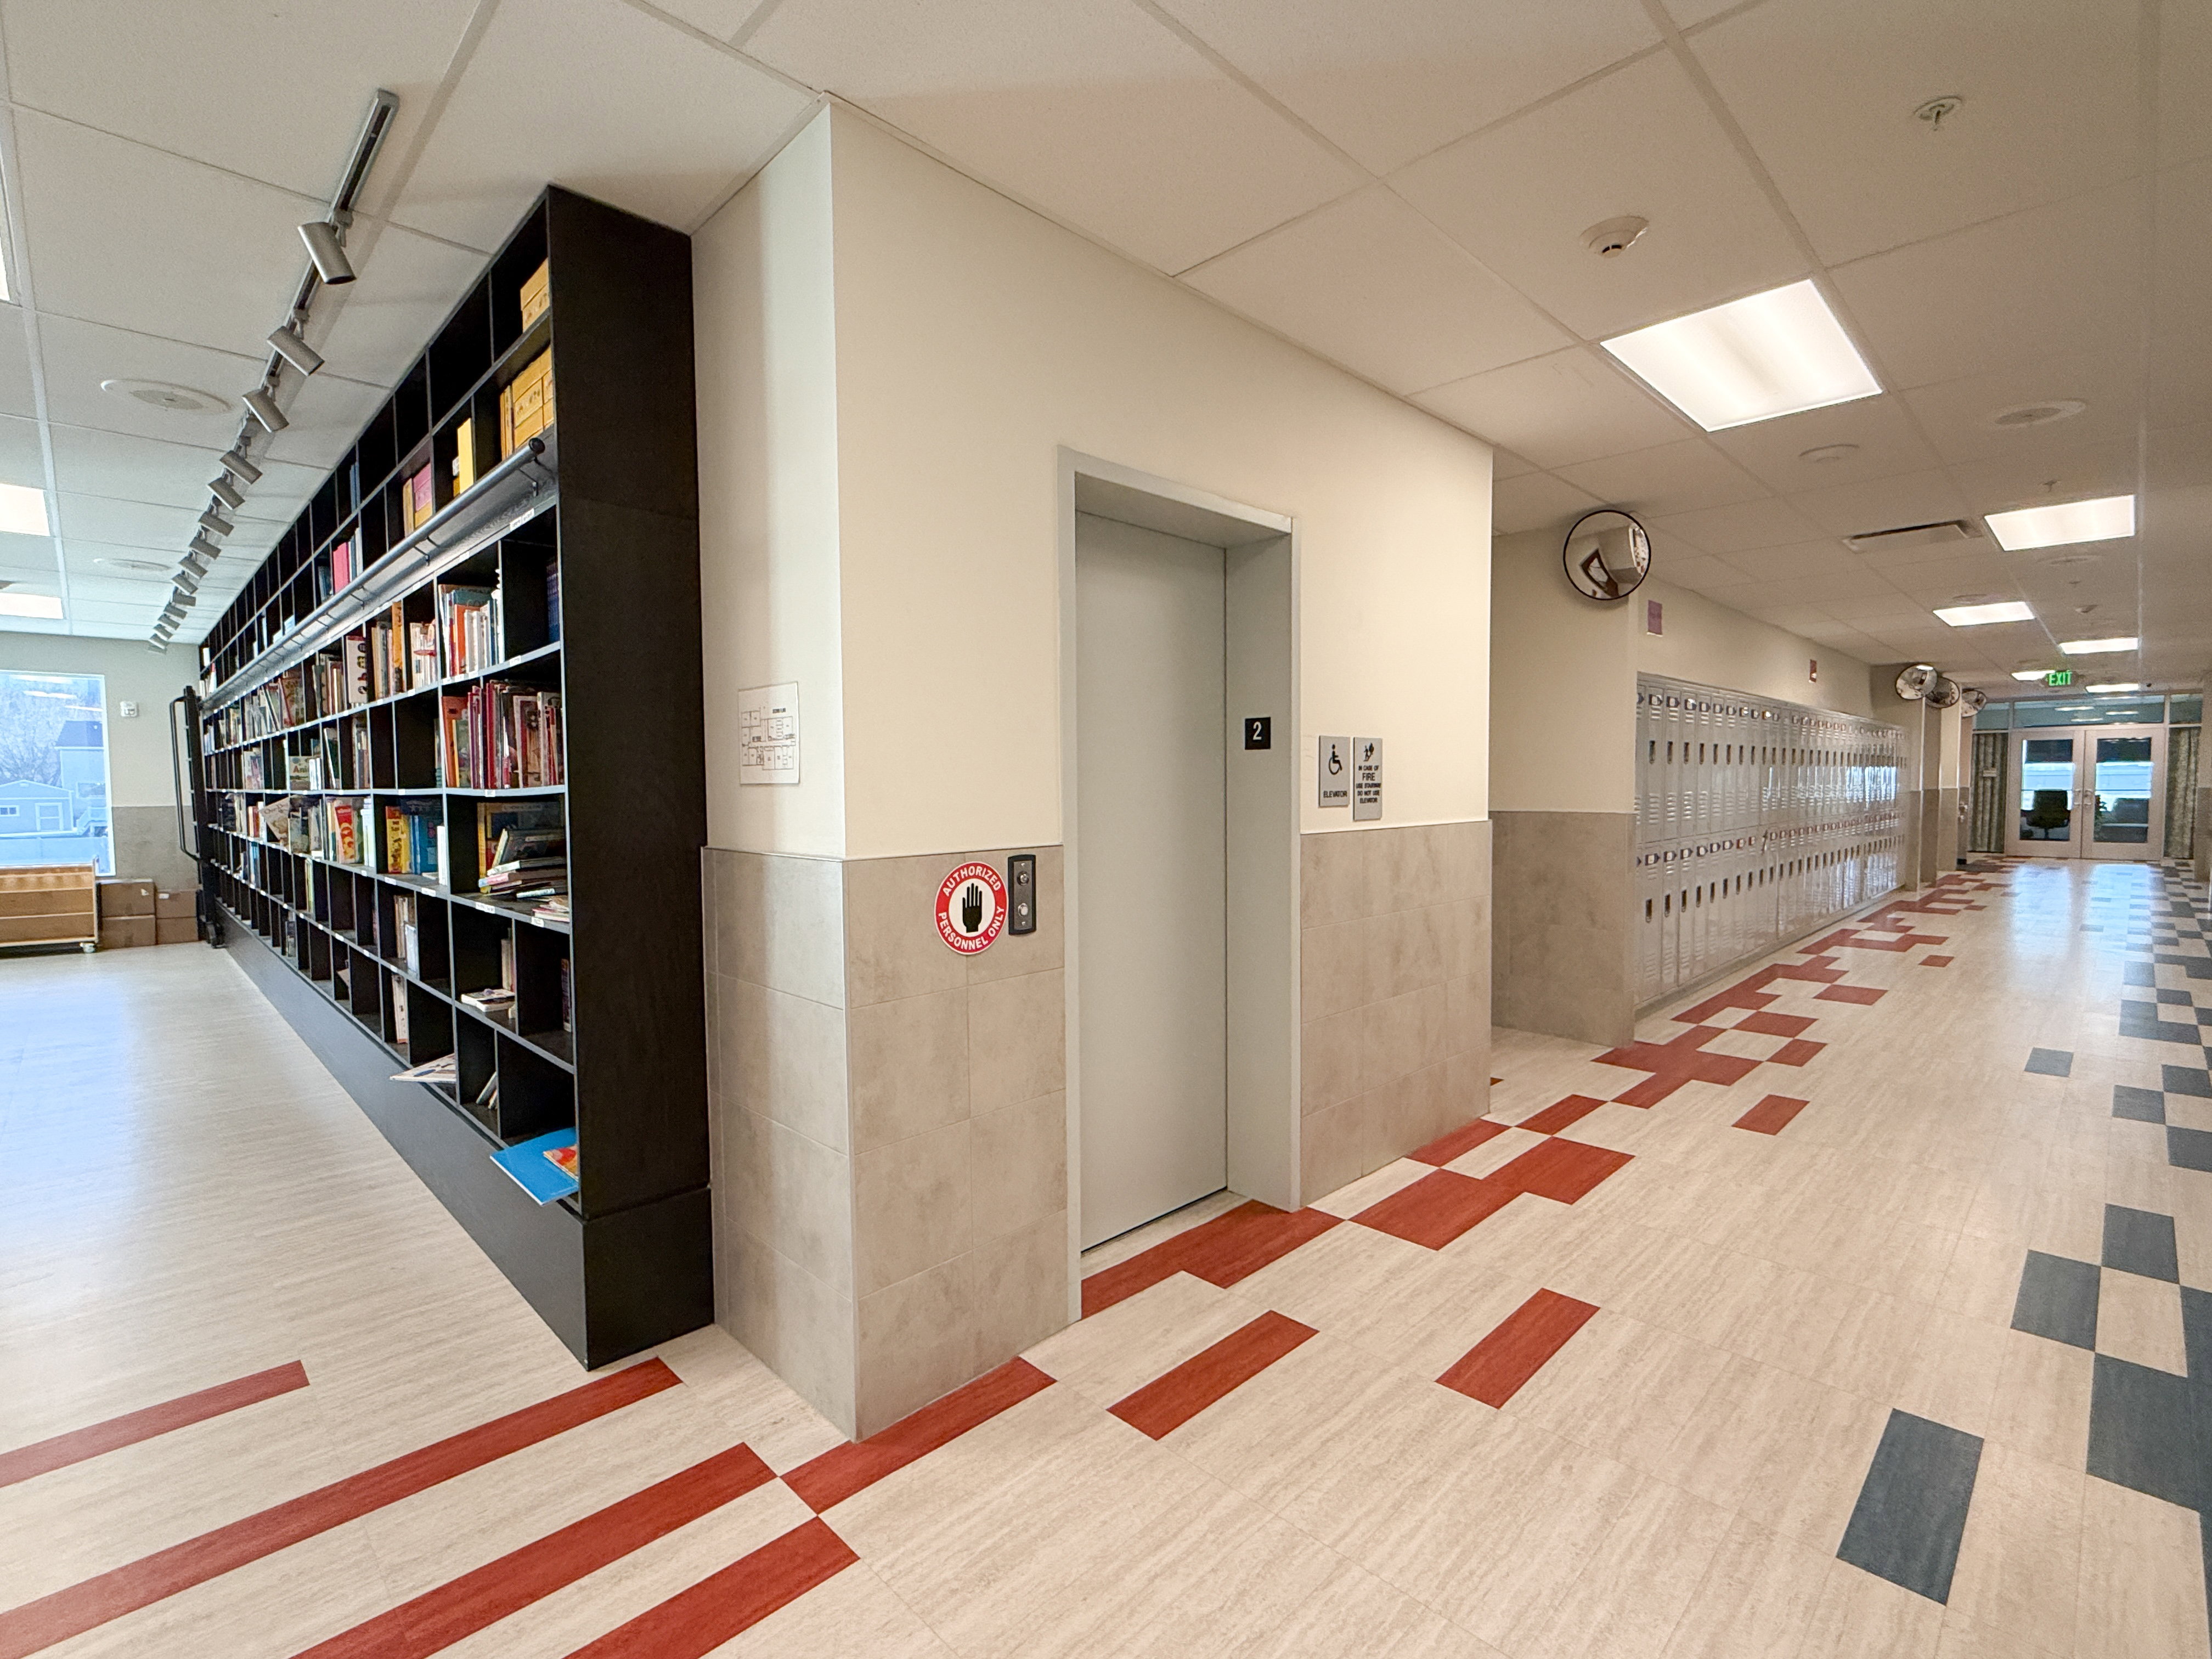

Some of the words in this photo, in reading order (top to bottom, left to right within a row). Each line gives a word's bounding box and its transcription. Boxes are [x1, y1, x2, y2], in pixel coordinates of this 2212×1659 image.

[2049, 671, 2072, 686] EXIT
[1252, 721, 1262, 741] 2
[1362, 772, 1375, 781] FIRE
[943, 866, 1002, 896] AUTHORIZED
[938, 911, 989, 950] PERSONNEL
[988, 905, 1005, 937] ONLY
